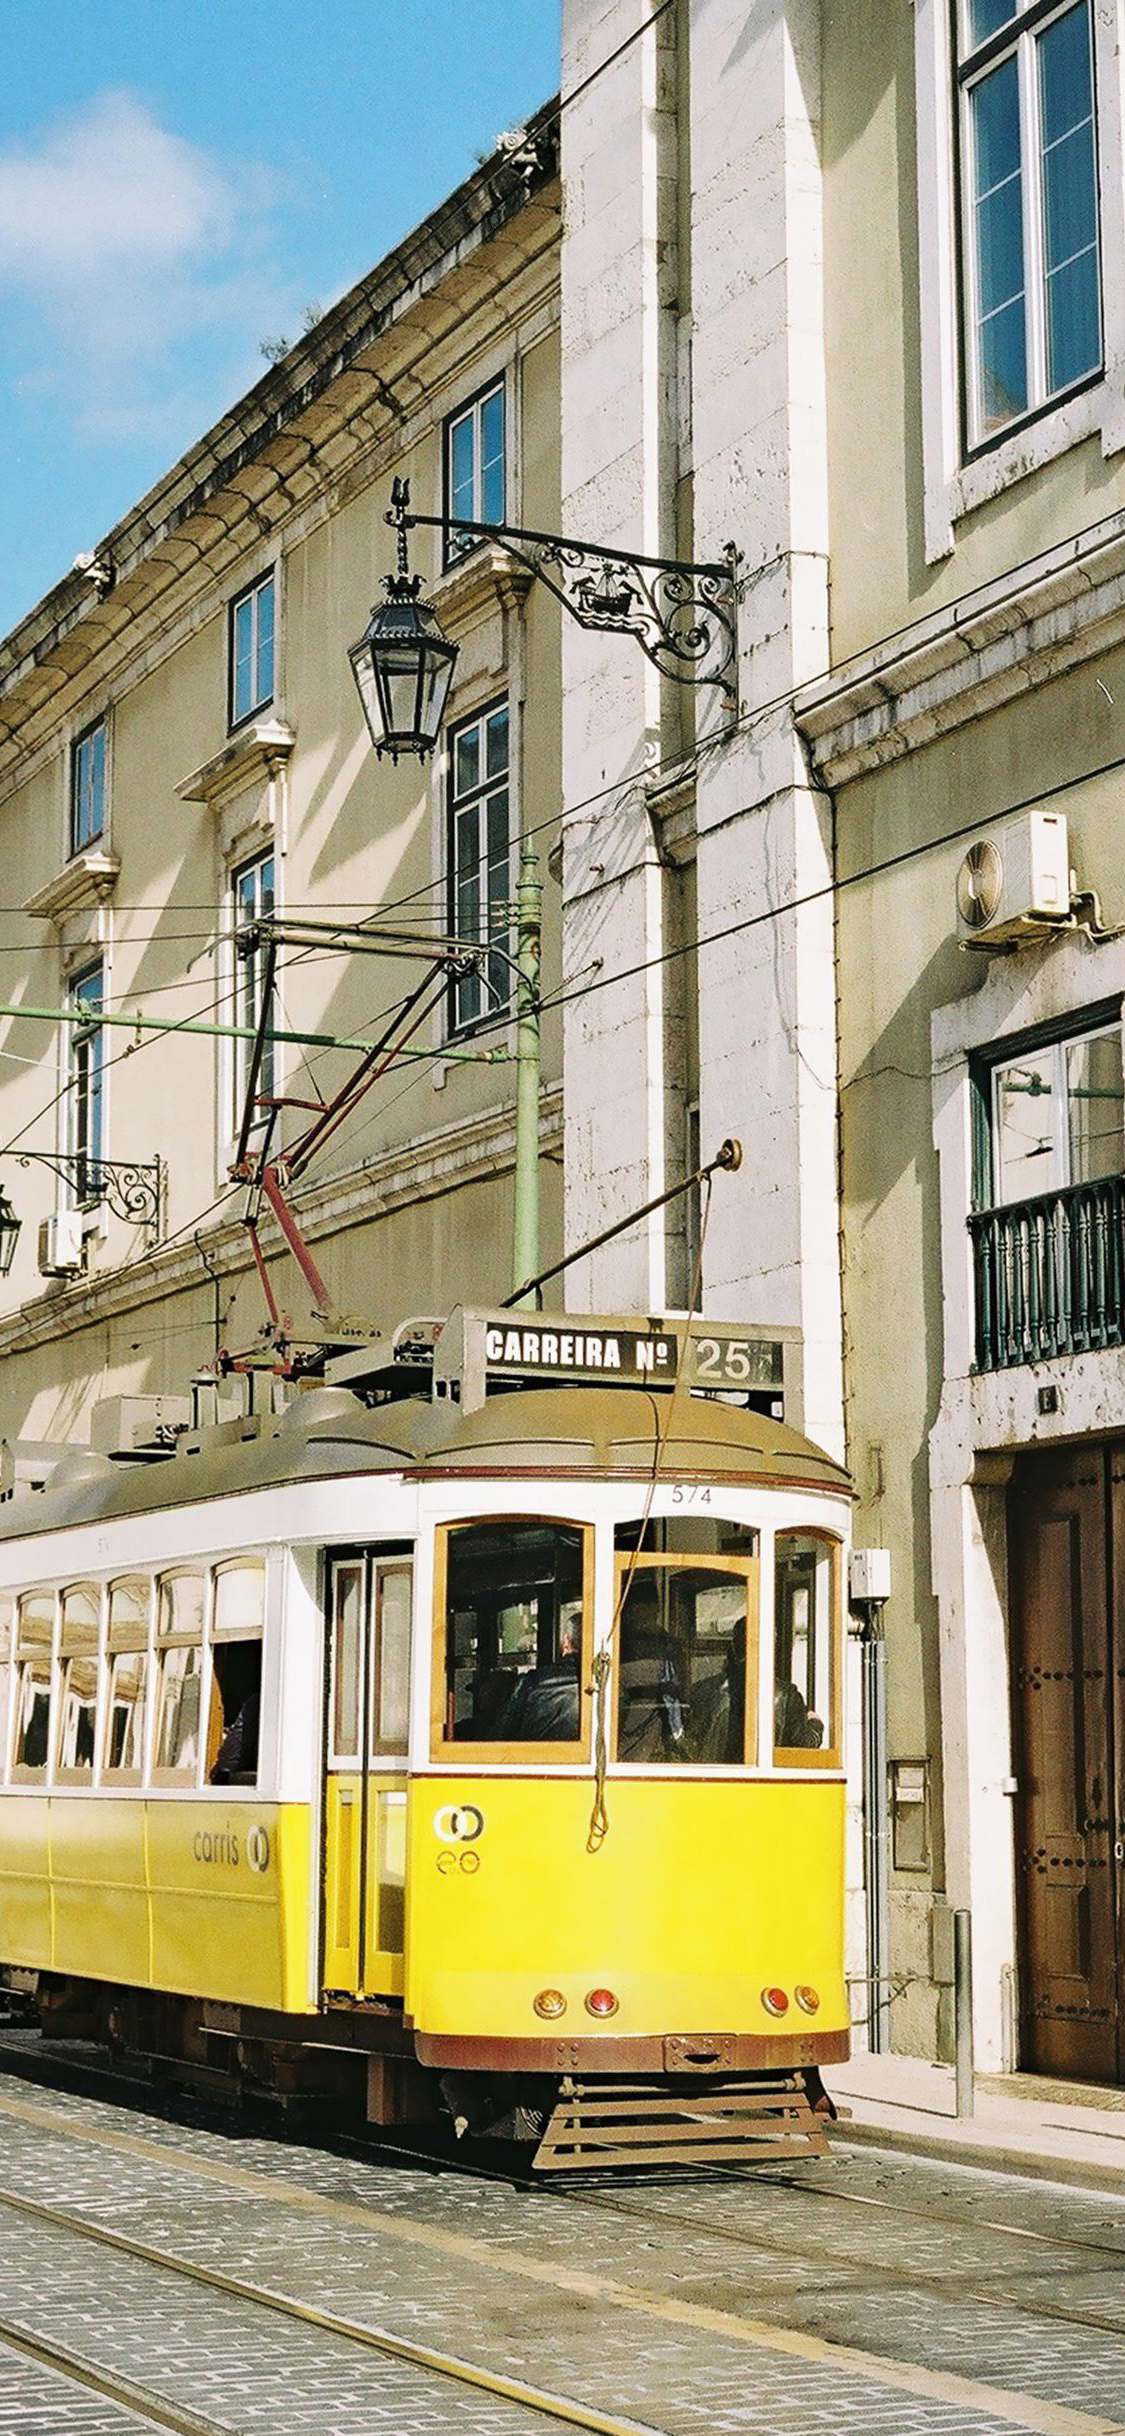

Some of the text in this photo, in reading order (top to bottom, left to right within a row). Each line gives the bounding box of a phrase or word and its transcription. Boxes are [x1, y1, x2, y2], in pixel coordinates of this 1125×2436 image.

[486, 1330, 621, 1368] CARREIRA
[636, 1340, 668, 1370] Nº
[672, 1484, 711, 1504] 574
[194, 1820, 239, 1866] carris
